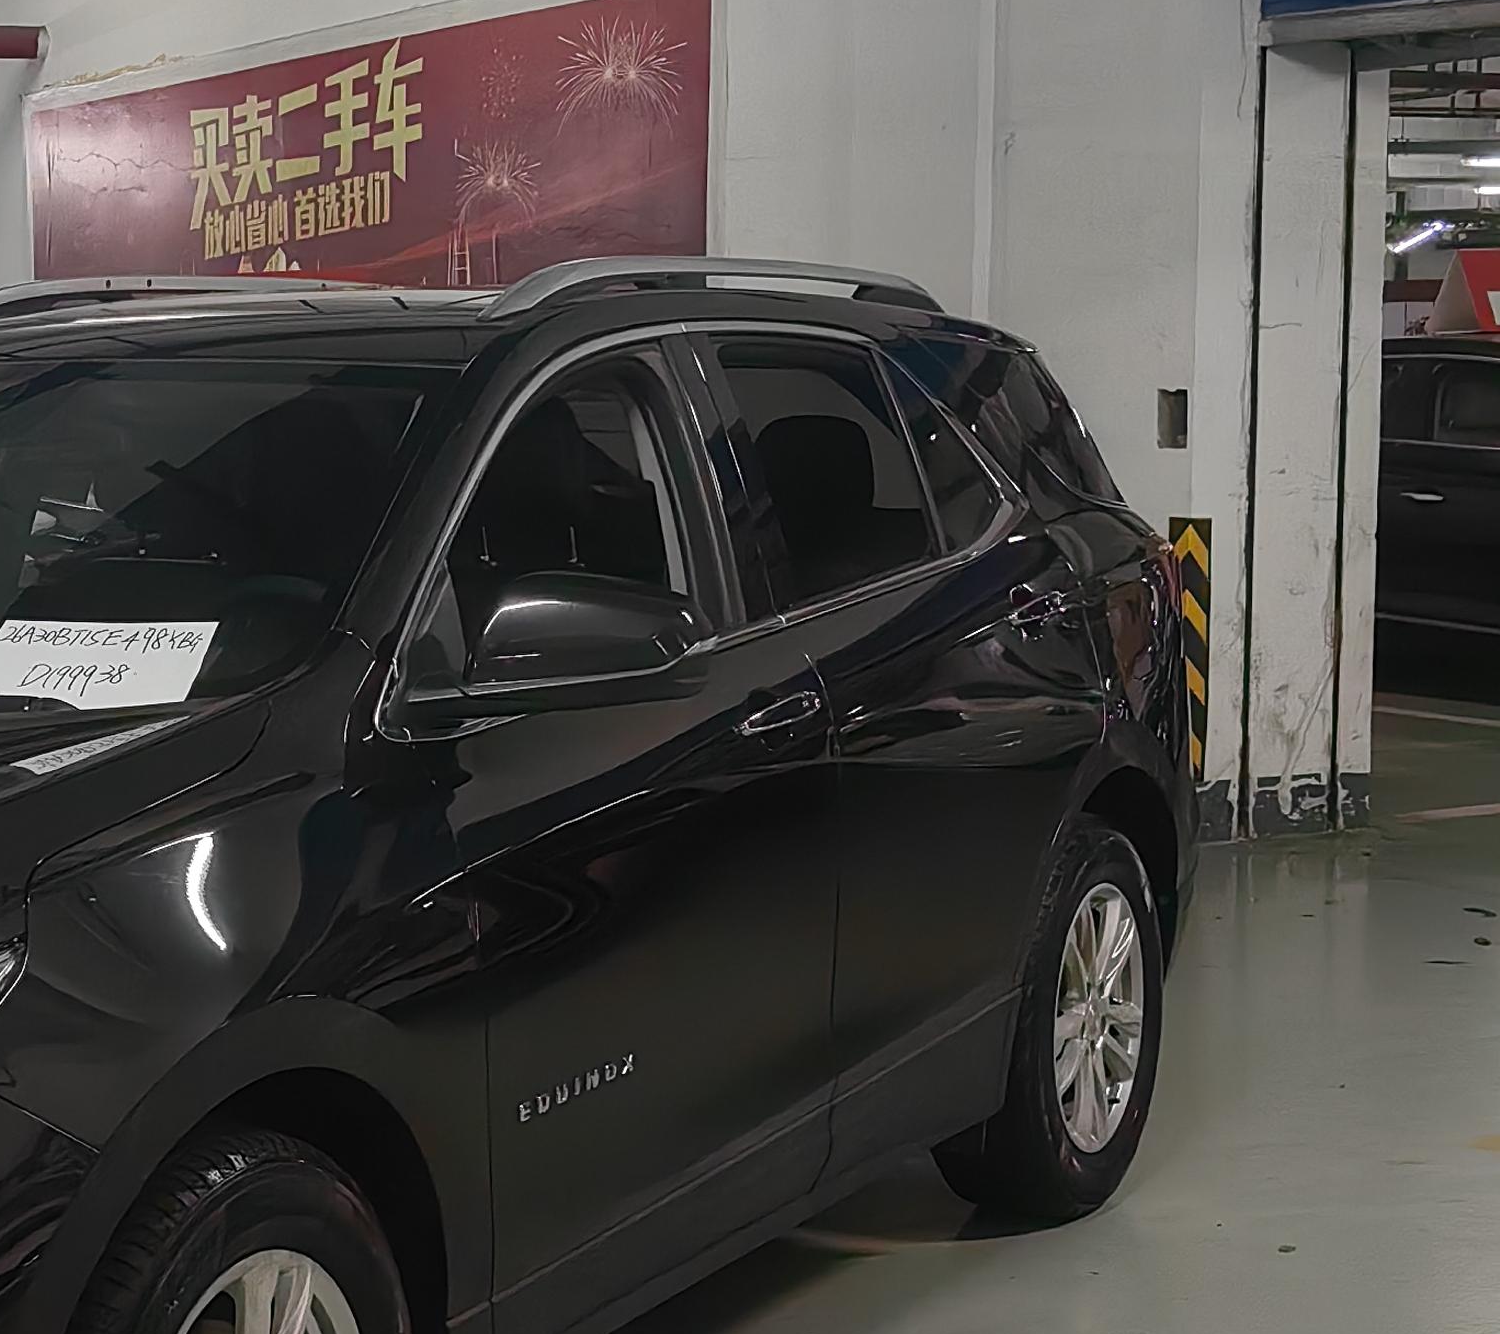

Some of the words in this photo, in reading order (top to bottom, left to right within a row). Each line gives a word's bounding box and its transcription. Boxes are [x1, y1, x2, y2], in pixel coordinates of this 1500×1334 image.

[190, 36, 424, 231] 买卖二手车
[204, 194, 290, 261] 放心省心
[294, 170, 391, 242] 首选我们
[17, 663, 130, 697] D199938
[518, 1053, 634, 1122] EQUINOX
